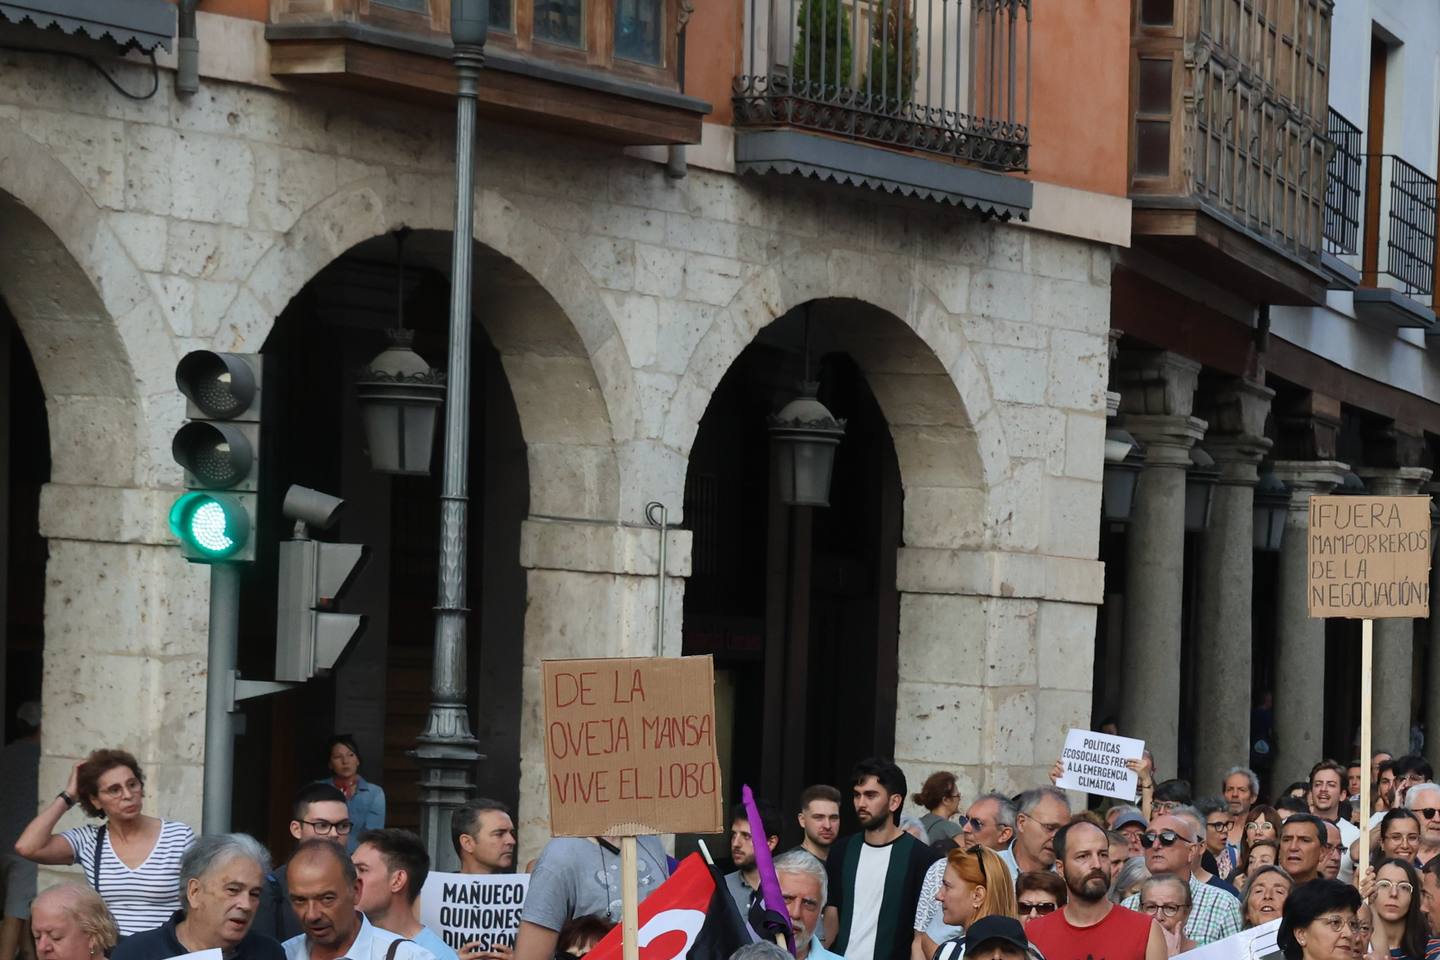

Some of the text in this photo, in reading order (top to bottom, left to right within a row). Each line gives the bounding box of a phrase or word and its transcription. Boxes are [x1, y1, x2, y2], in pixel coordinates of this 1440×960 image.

[1312, 499, 1402, 529] ¡FUERA
[1312, 529, 1428, 555] MAMPORREROS
[1312, 558, 1367, 580] DE LA
[1312, 576, 1428, 608] NEGOCIACIÓN!
[555, 669, 645, 708] DE LA
[550, 714, 712, 759] OVEJA MANSA
[1083, 738, 1121, 754] POLÍTICAS
[1063, 748, 1110, 766] ECOSOCIALES
[553, 762, 717, 804] VIVE EL LOBO
[1067, 762, 1128, 781] A LA EMERGENCIA
[1078, 776, 1116, 792] CLIMÁTICA
[443, 881, 524, 905] MAÑUECO
[440, 905, 523, 929] QUIÑONES
